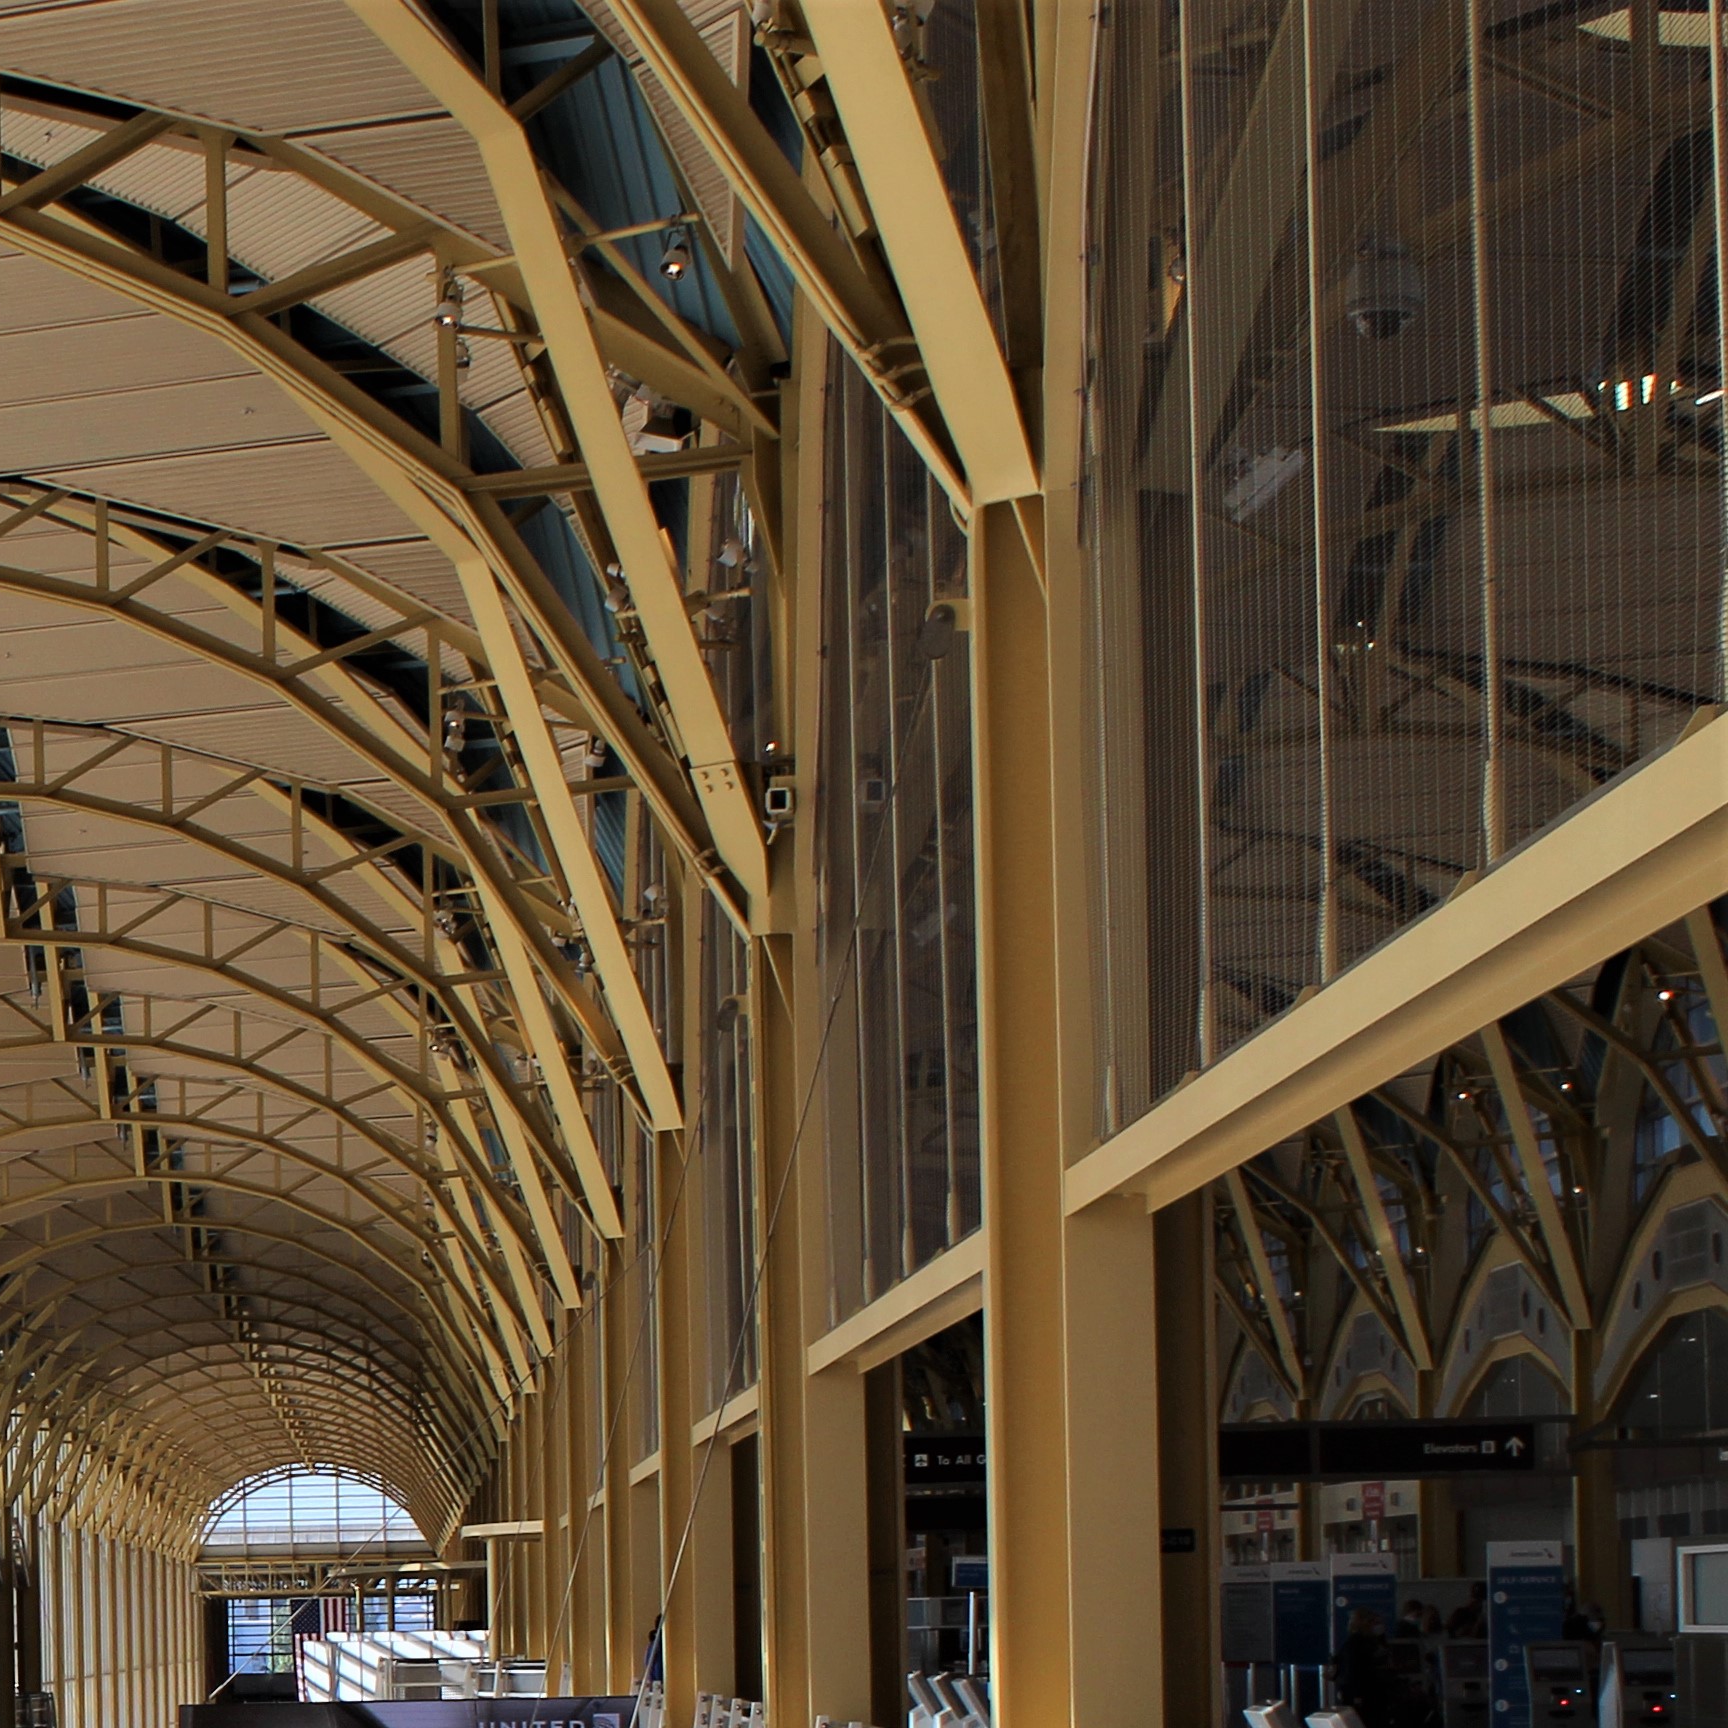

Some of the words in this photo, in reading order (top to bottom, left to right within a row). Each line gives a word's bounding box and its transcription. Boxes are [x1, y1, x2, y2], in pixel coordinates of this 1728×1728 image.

[1423, 1442, 1477, 1454] Elevators
[936, 1455, 951, 1466] To
[954, 1454, 972, 1466] All
